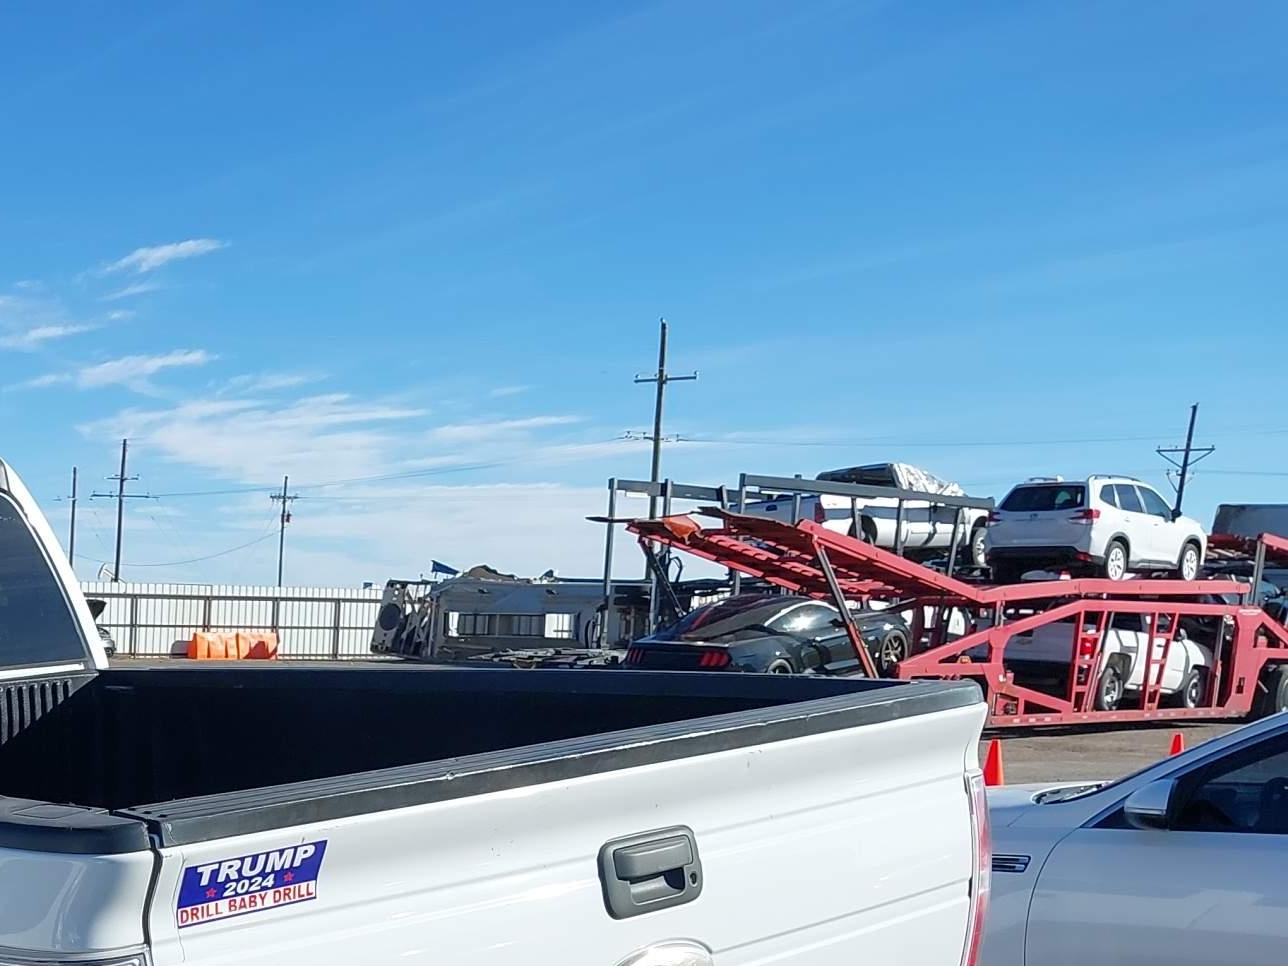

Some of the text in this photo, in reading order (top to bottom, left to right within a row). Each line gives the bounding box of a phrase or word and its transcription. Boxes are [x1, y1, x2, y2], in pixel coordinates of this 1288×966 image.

[197, 844, 316, 887] TRUMP
[222, 874, 275, 898] 2024
[180, 882, 314, 924] DRILL BABY DRILL
